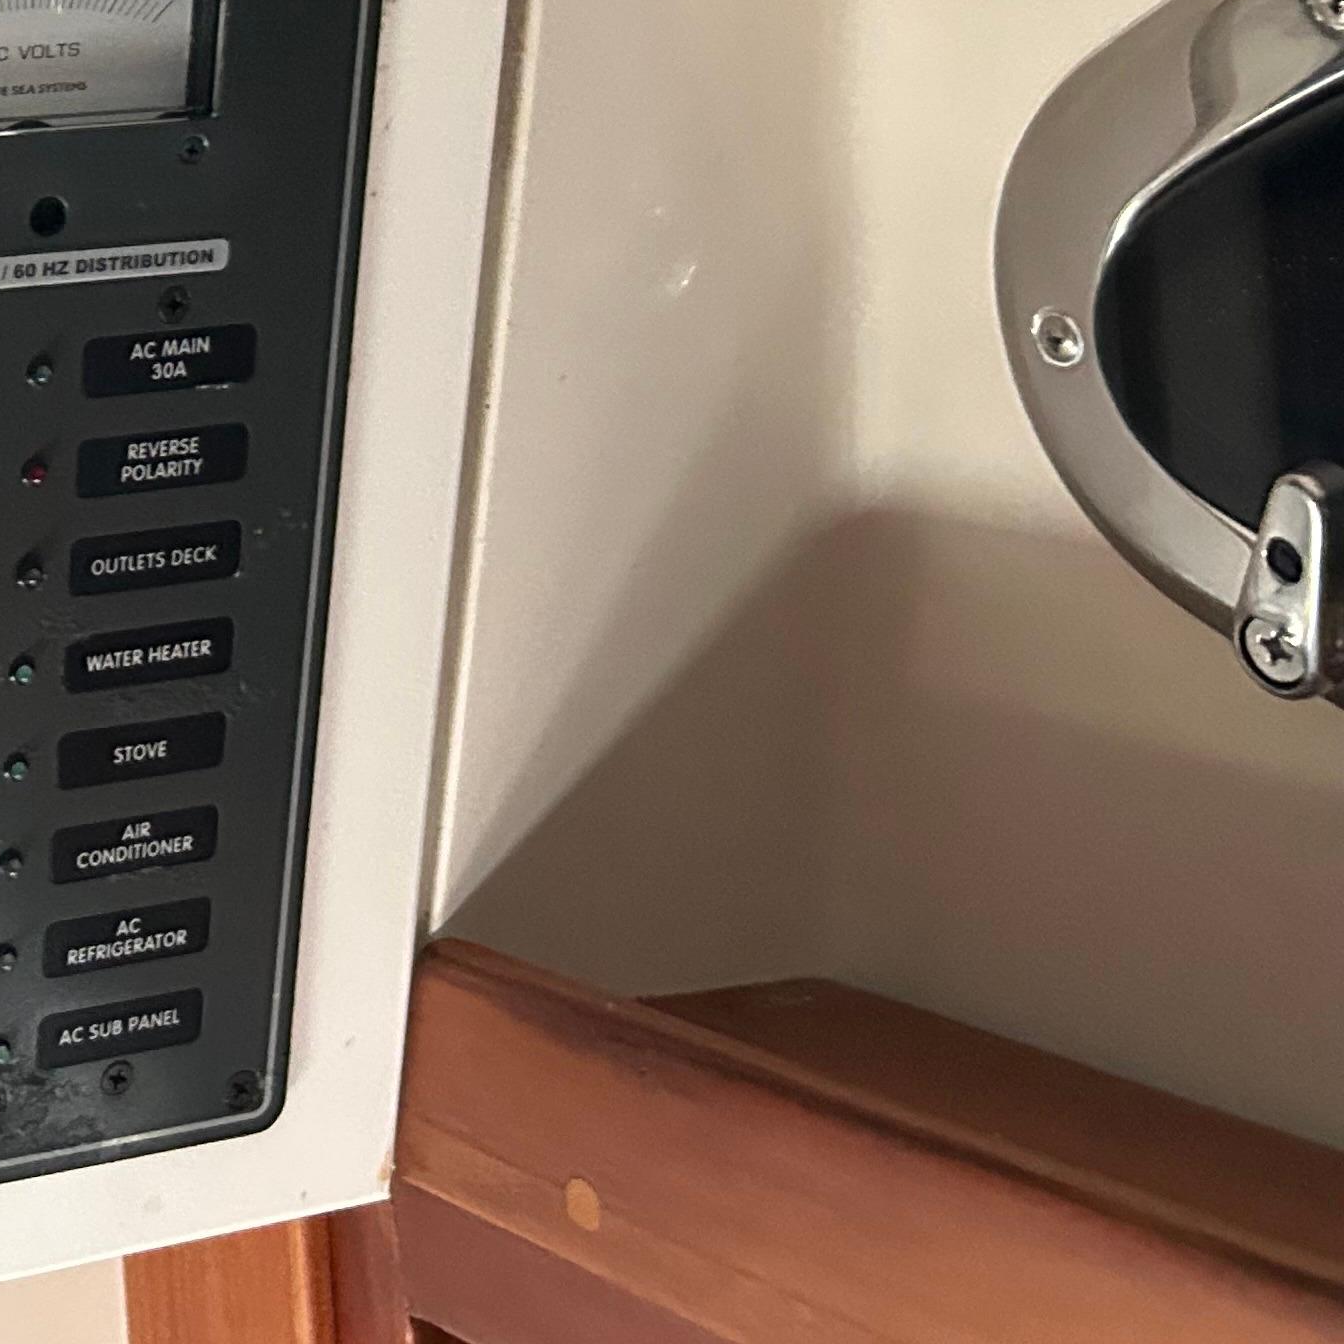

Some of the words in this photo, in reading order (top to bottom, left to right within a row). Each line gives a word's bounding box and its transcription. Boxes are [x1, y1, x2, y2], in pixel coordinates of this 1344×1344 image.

[18, 43, 81, 59] VOLTS
[12, 85, 37, 95] SEA
[39, 81, 87, 94] SYSTEMS
[14, 262, 36, 279] 60
[42, 260, 70, 277] HZ
[75, 248, 215, 275] DISTRIBUTION
[130, 341, 156, 361] AC
[162, 336, 211, 356] MAIN
[150, 360, 187, 380] 30A
[127, 437, 200, 460] REVERSE
[120, 459, 204, 483] POLARITY
[91, 552, 165, 575] OUTLETS
[171, 545, 217, 566] DECK
[86, 649, 143, 672] WATER
[148, 639, 212, 662] HEATER
[113, 740, 168, 764] STOVE
[121, 822, 151, 841] AIR
[76, 835, 193, 869] CONDITIONER
[116, 918, 142, 935] AC
[67, 929, 187, 966] REFRIGERATOR
[59, 1026, 83, 1046] AC
[88, 1018, 122, 1040] SUB
[128, 1008, 180, 1033] PANEL
